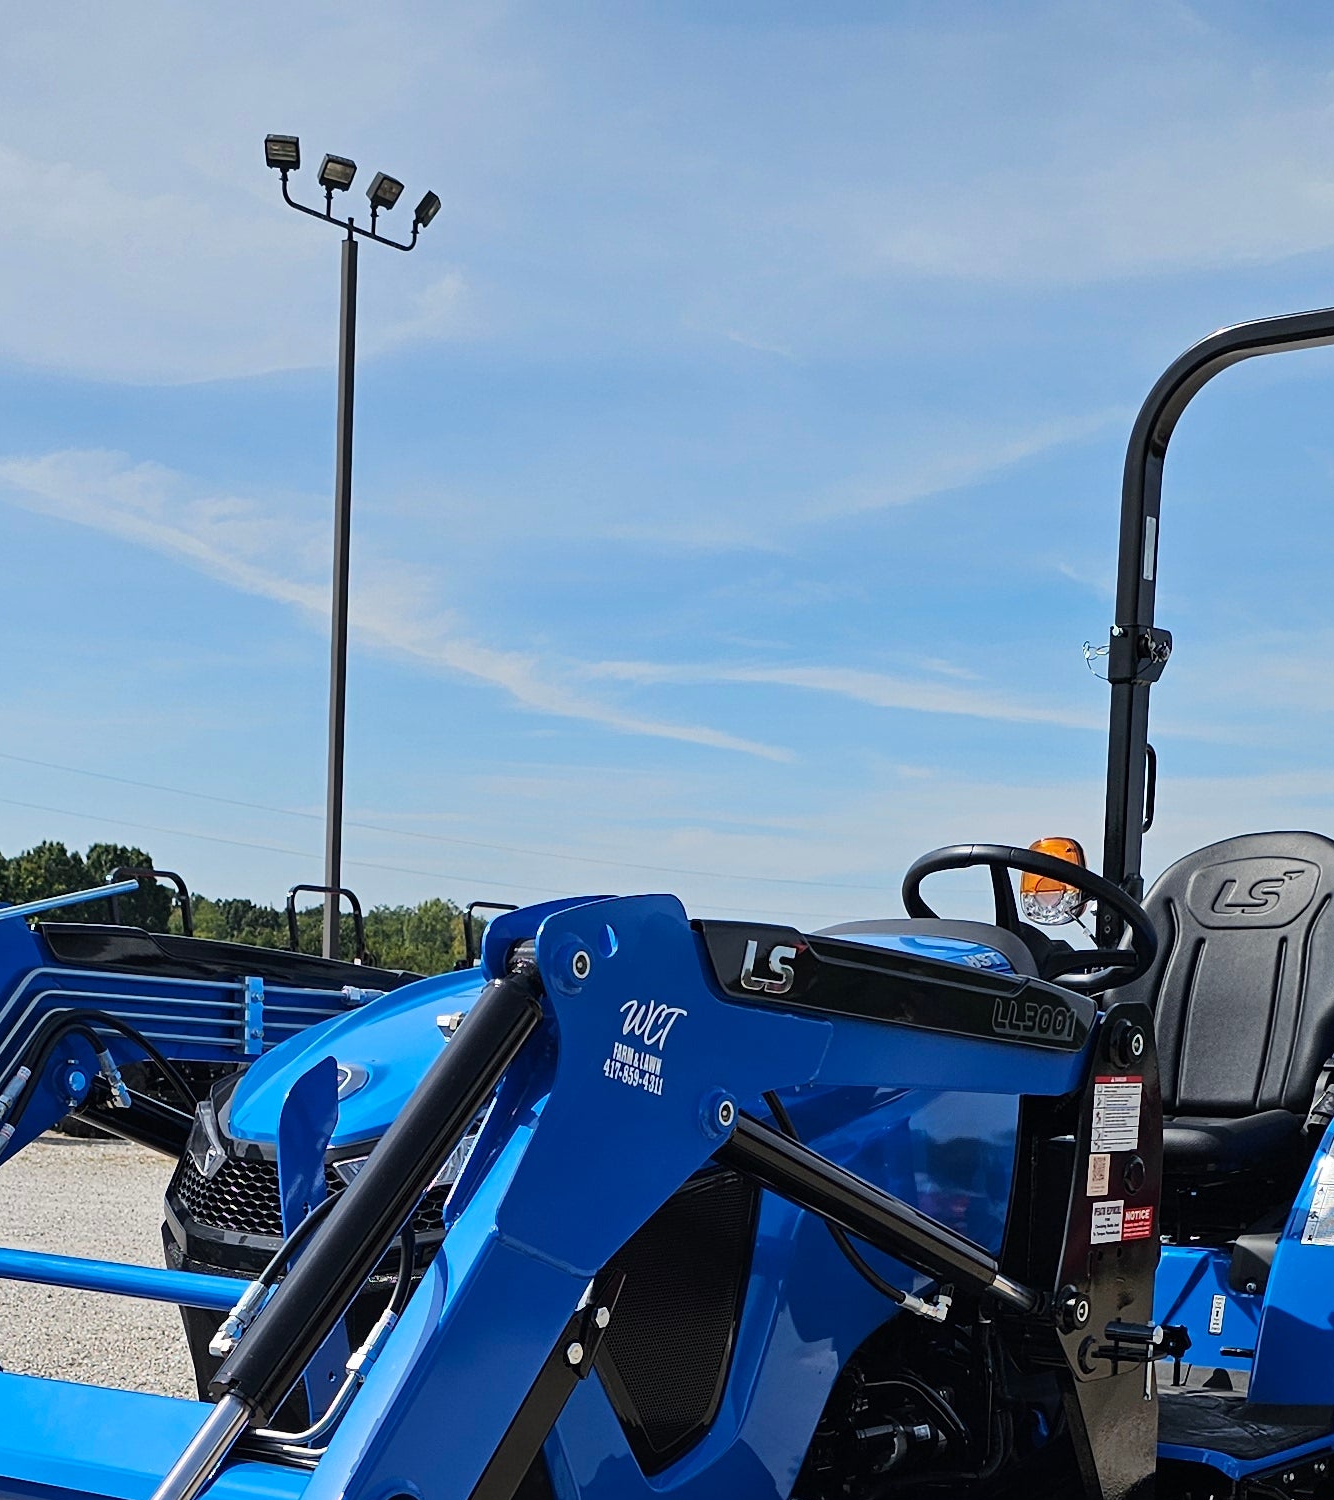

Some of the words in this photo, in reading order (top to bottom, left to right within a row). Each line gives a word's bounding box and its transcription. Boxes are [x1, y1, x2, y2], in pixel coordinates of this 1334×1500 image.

[1211, 879, 1285, 916] LS
[741, 939, 797, 994] LS
[619, 999, 688, 1051] WCT
[992, 998, 1077, 1042] LL3001
[612, 1041, 635, 1066] FARM
[632, 1052, 639, 1069] &
[639, 1051, 663, 1077] LAWN
[1125, 1208, 1151, 1221] NOTICE
